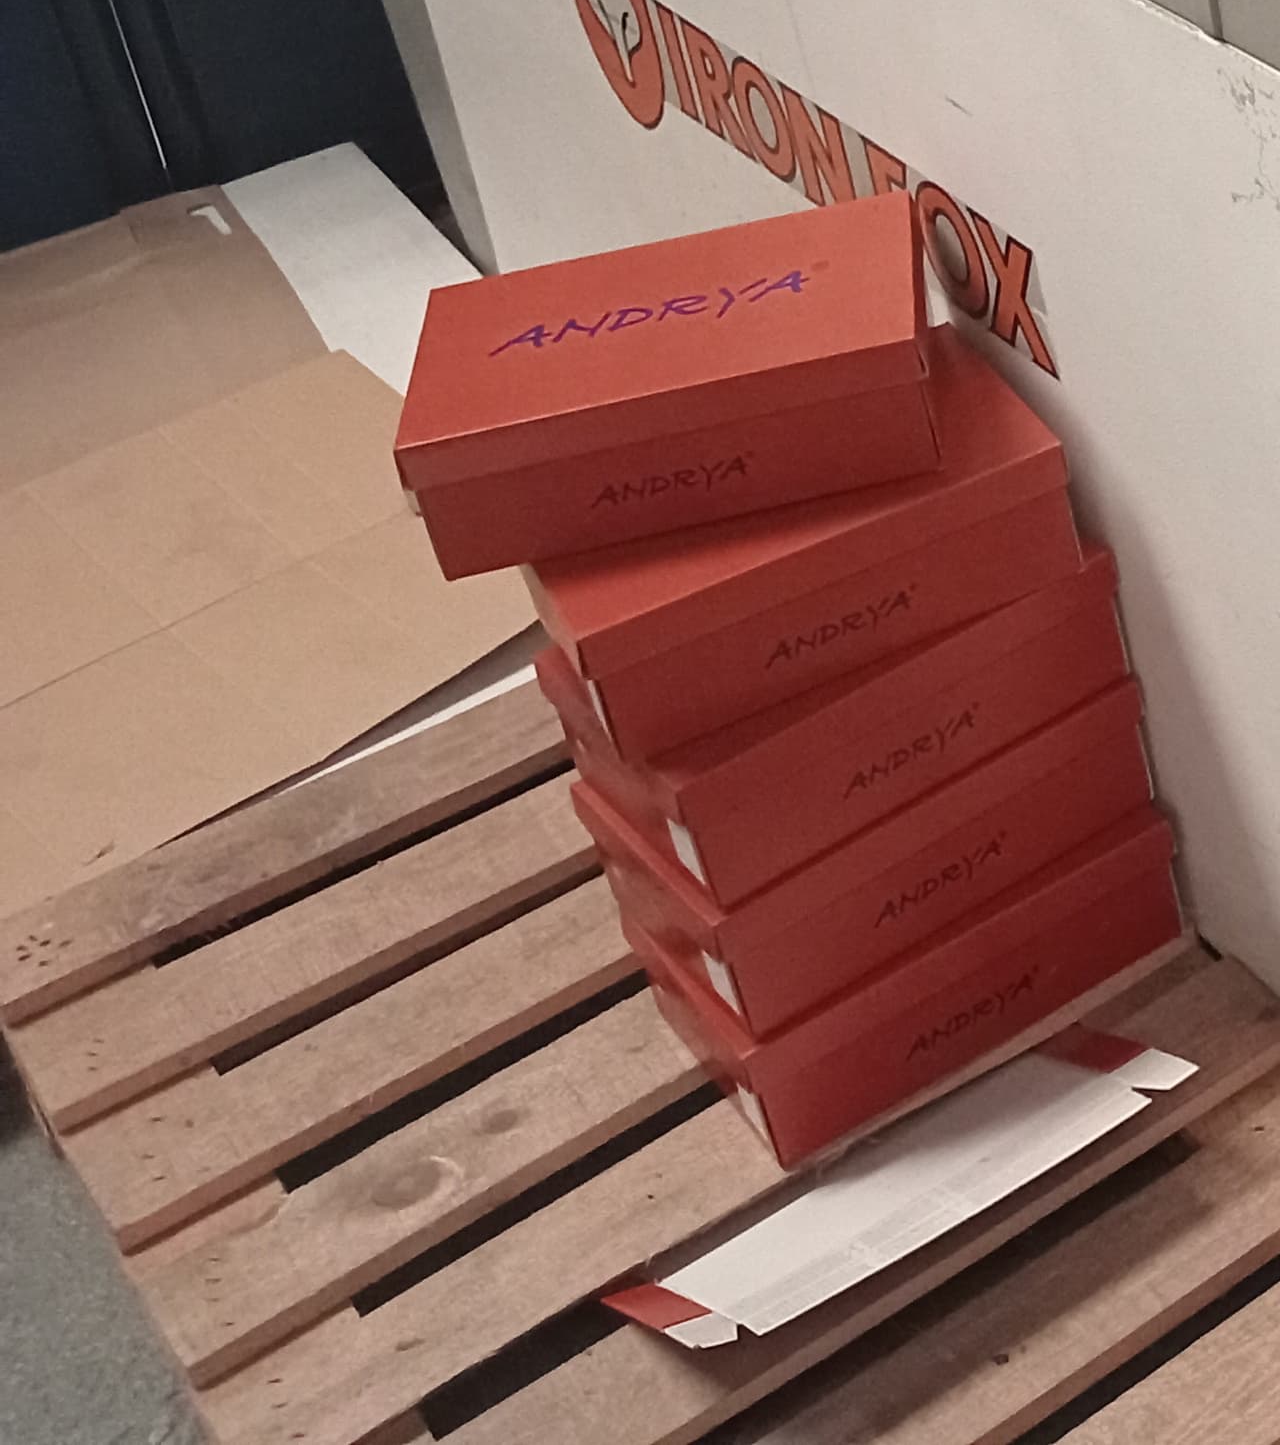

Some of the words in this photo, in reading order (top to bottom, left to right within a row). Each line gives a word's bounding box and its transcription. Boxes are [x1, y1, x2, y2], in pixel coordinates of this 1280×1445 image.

[488, 269, 810, 356] ANDRYA
[590, 454, 750, 509] ANDRYA
[764, 590, 912, 670] ANDRYA
[842, 709, 976, 799] ANDRYA
[873, 838, 1004, 929] ANDRYA
[906, 971, 1035, 1061] ANDRYA
